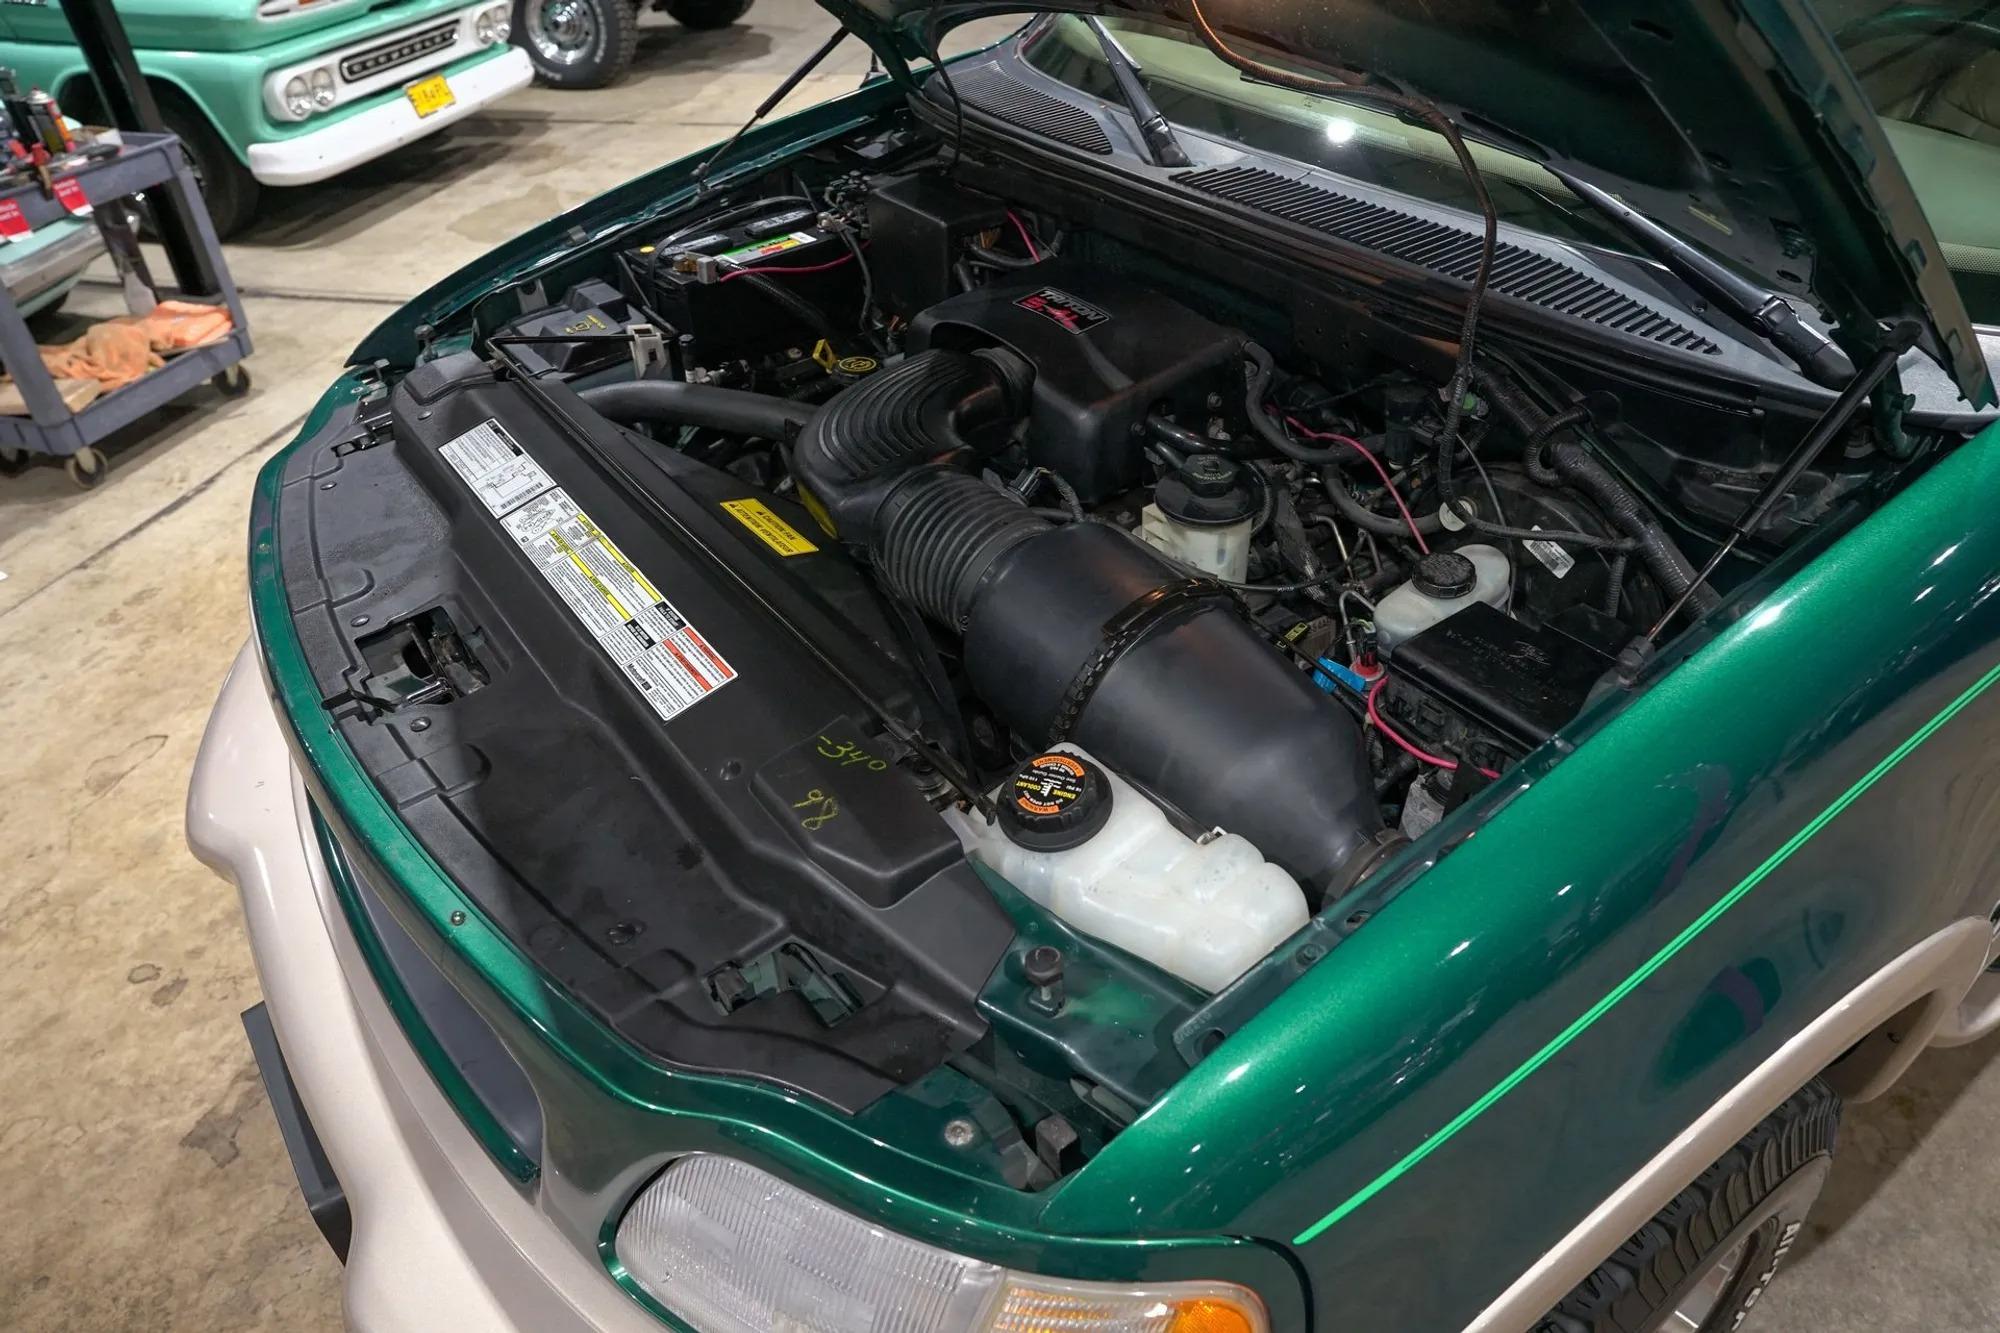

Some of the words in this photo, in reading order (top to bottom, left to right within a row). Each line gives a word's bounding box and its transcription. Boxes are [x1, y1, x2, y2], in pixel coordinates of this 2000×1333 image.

[1040, 289, 1104, 321] TRITON
[1016, 781, 1041, 790] COOLANT
[1053, 789, 1076, 799] ENGINE
